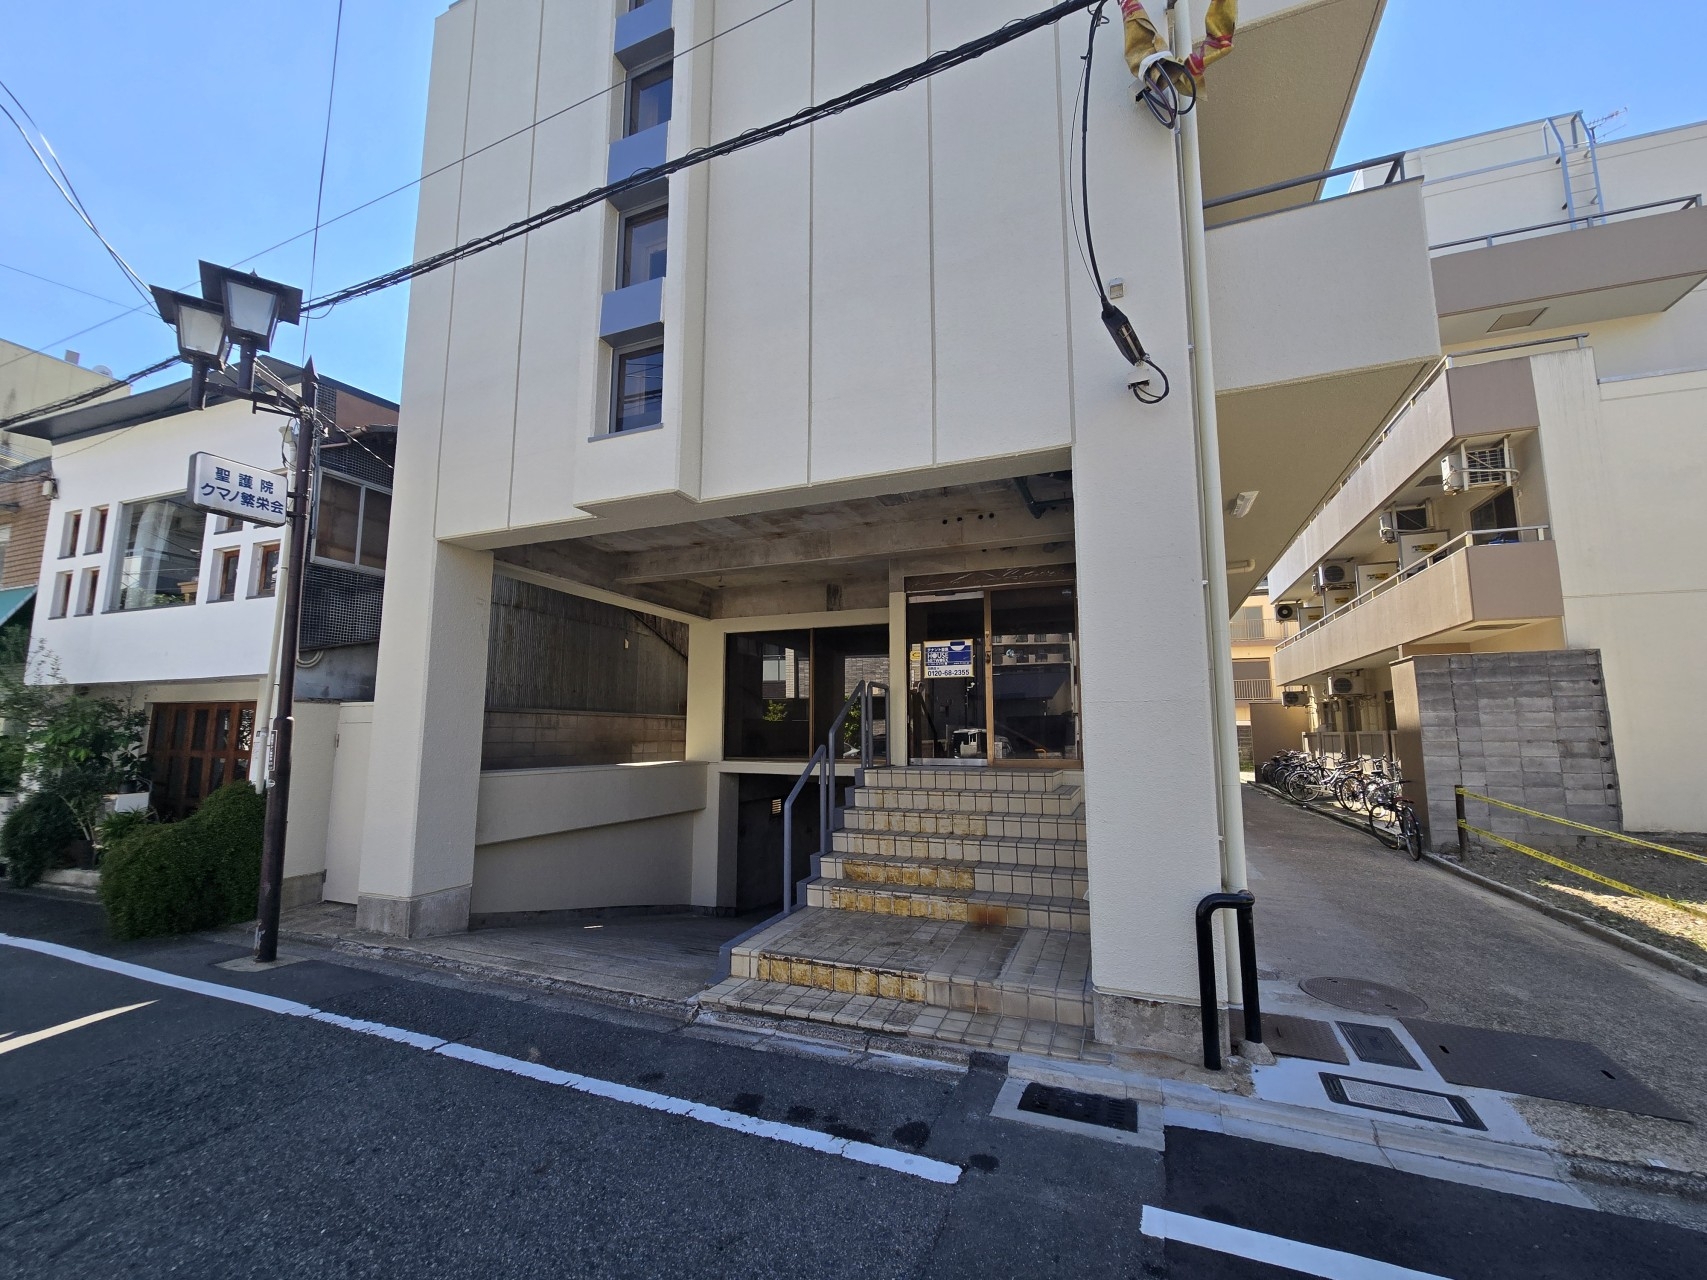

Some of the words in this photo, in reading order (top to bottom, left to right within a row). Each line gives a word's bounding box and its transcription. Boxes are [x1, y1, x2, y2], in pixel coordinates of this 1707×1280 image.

[214, 467, 274, 494] 聖護院
[201, 483, 284, 514] クマノ繁栄会
